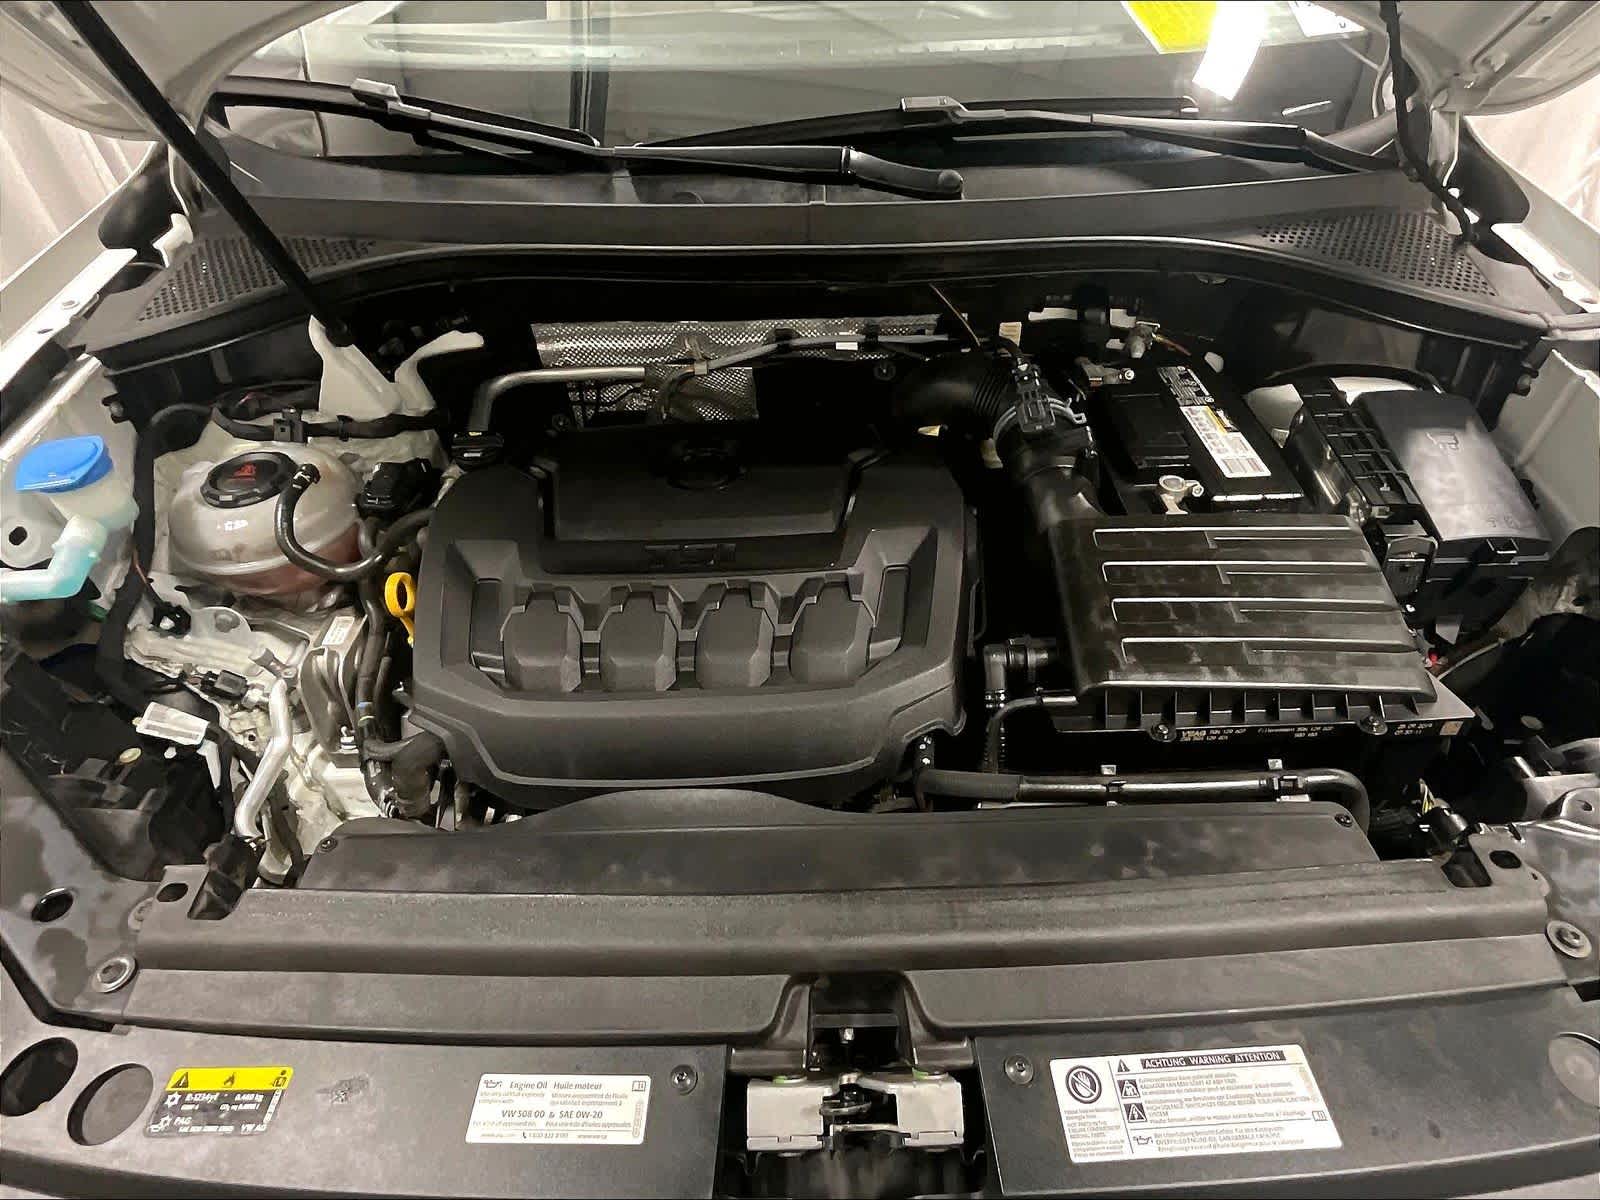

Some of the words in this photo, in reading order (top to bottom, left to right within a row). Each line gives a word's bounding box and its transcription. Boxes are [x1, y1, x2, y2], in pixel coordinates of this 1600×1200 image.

[1145, 1057, 1186, 1068] ACHTUNG
[1189, 1054, 1231, 1066] WARNING
[1235, 1051, 1281, 1063] ATTENTION
[509, 1081, 535, 1091] Engine
[536, 1080, 548, 1089] Oil
[553, 1081, 574, 1090] Huile
[574, 1081, 603, 1090] moteur
[501, 1109, 517, 1118] VW
[517, 1109, 533, 1118] 508
[534, 1109, 546, 1119] 00
[559, 1110, 574, 1119] SAE
[575, 1110, 603, 1119] 0W-20
